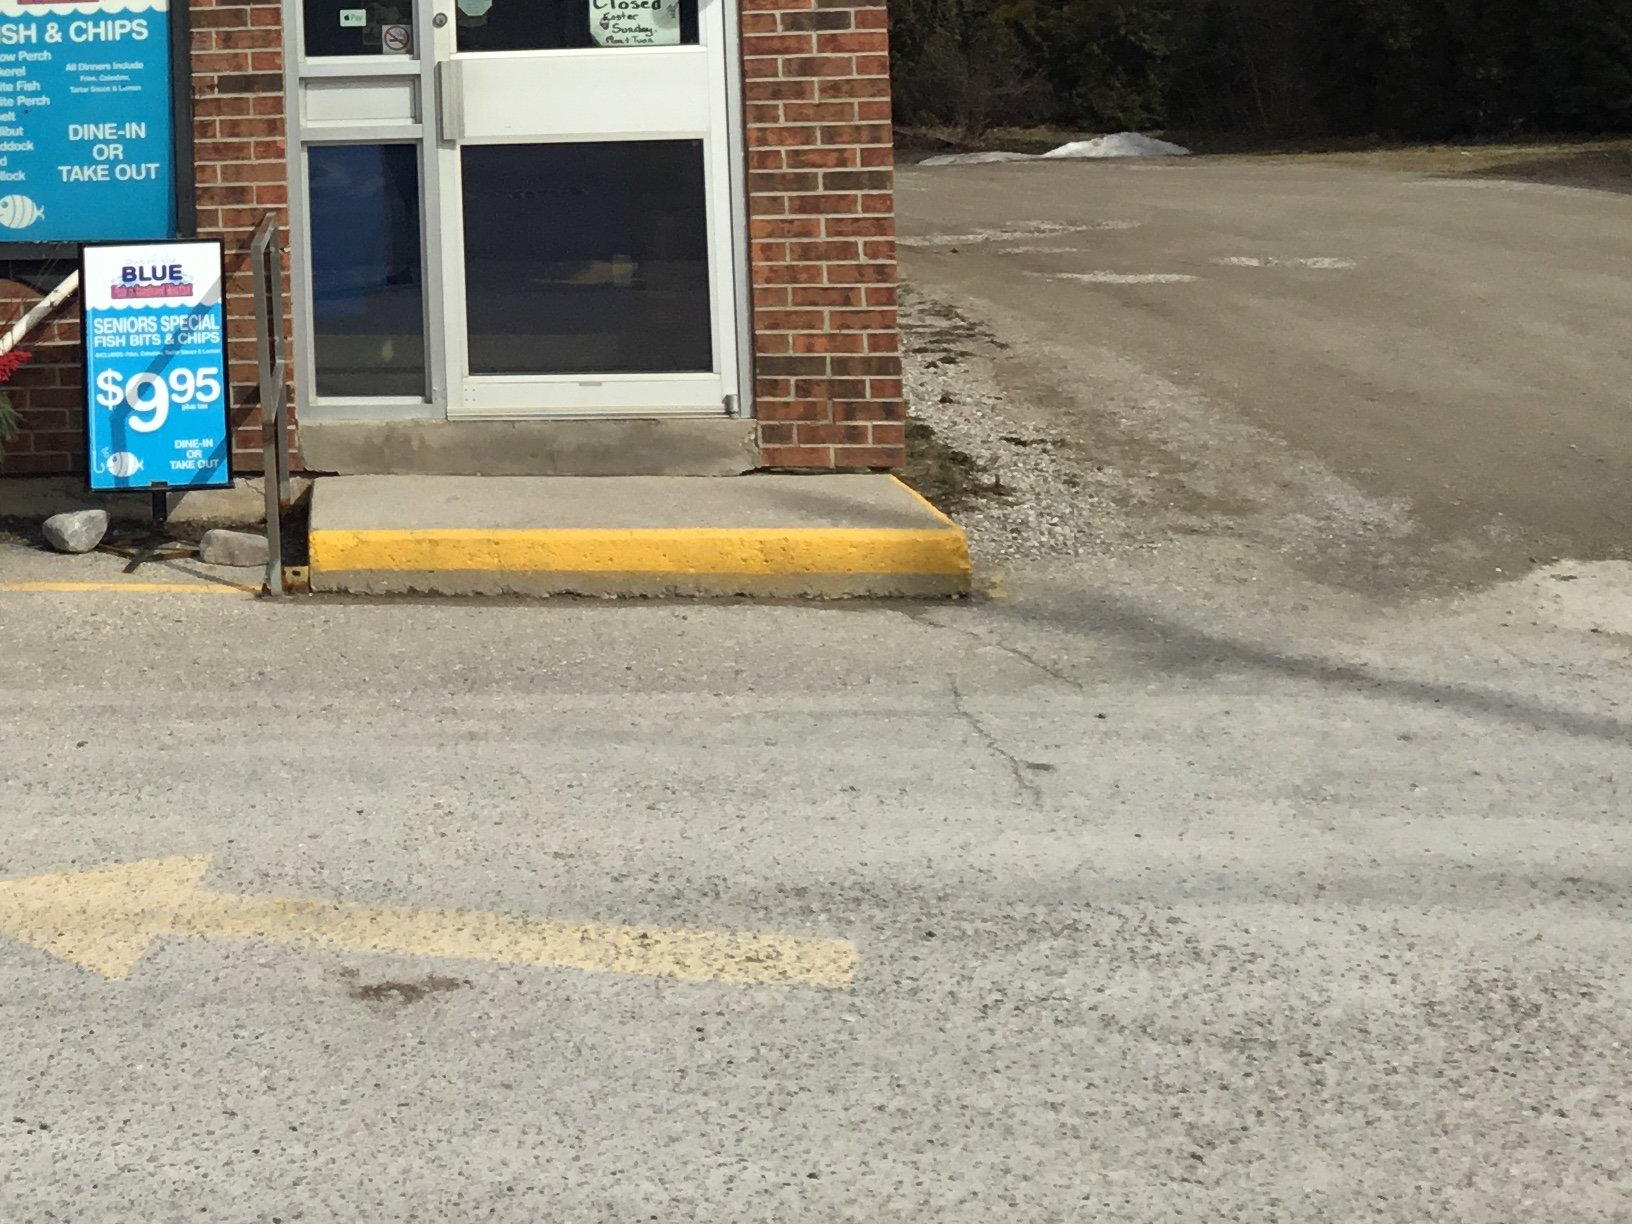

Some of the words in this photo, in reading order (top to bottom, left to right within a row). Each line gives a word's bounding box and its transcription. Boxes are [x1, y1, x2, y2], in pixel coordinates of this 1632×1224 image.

[44, 21, 62, 43] &
[69, 19, 149, 43] CHIPS
[18, 50, 52, 62] Perch
[16, 80, 41, 92] Fish
[16, 95, 51, 106] Perch
[68, 122, 146, 141] DINE-IN
[92, 144, 124, 161] OR
[58, 165, 111, 182] TAKE
[115, 163, 160, 181] OUT
[121, 264, 183, 282] BLUE
[93, 316, 158, 335] SENIORS
[160, 314, 220, 332] SPECIAL
[94, 335, 126, 347] FISH
[129, 333, 162, 346] BITS
[164, 333, 174, 345] &
[177, 331, 221, 344] CHIPS
[174, 439, 214, 449] DINE-IN
[186, 450, 203, 458] OR
[169, 460, 194, 470] TAKE
[197, 459, 219, 468] OUT
